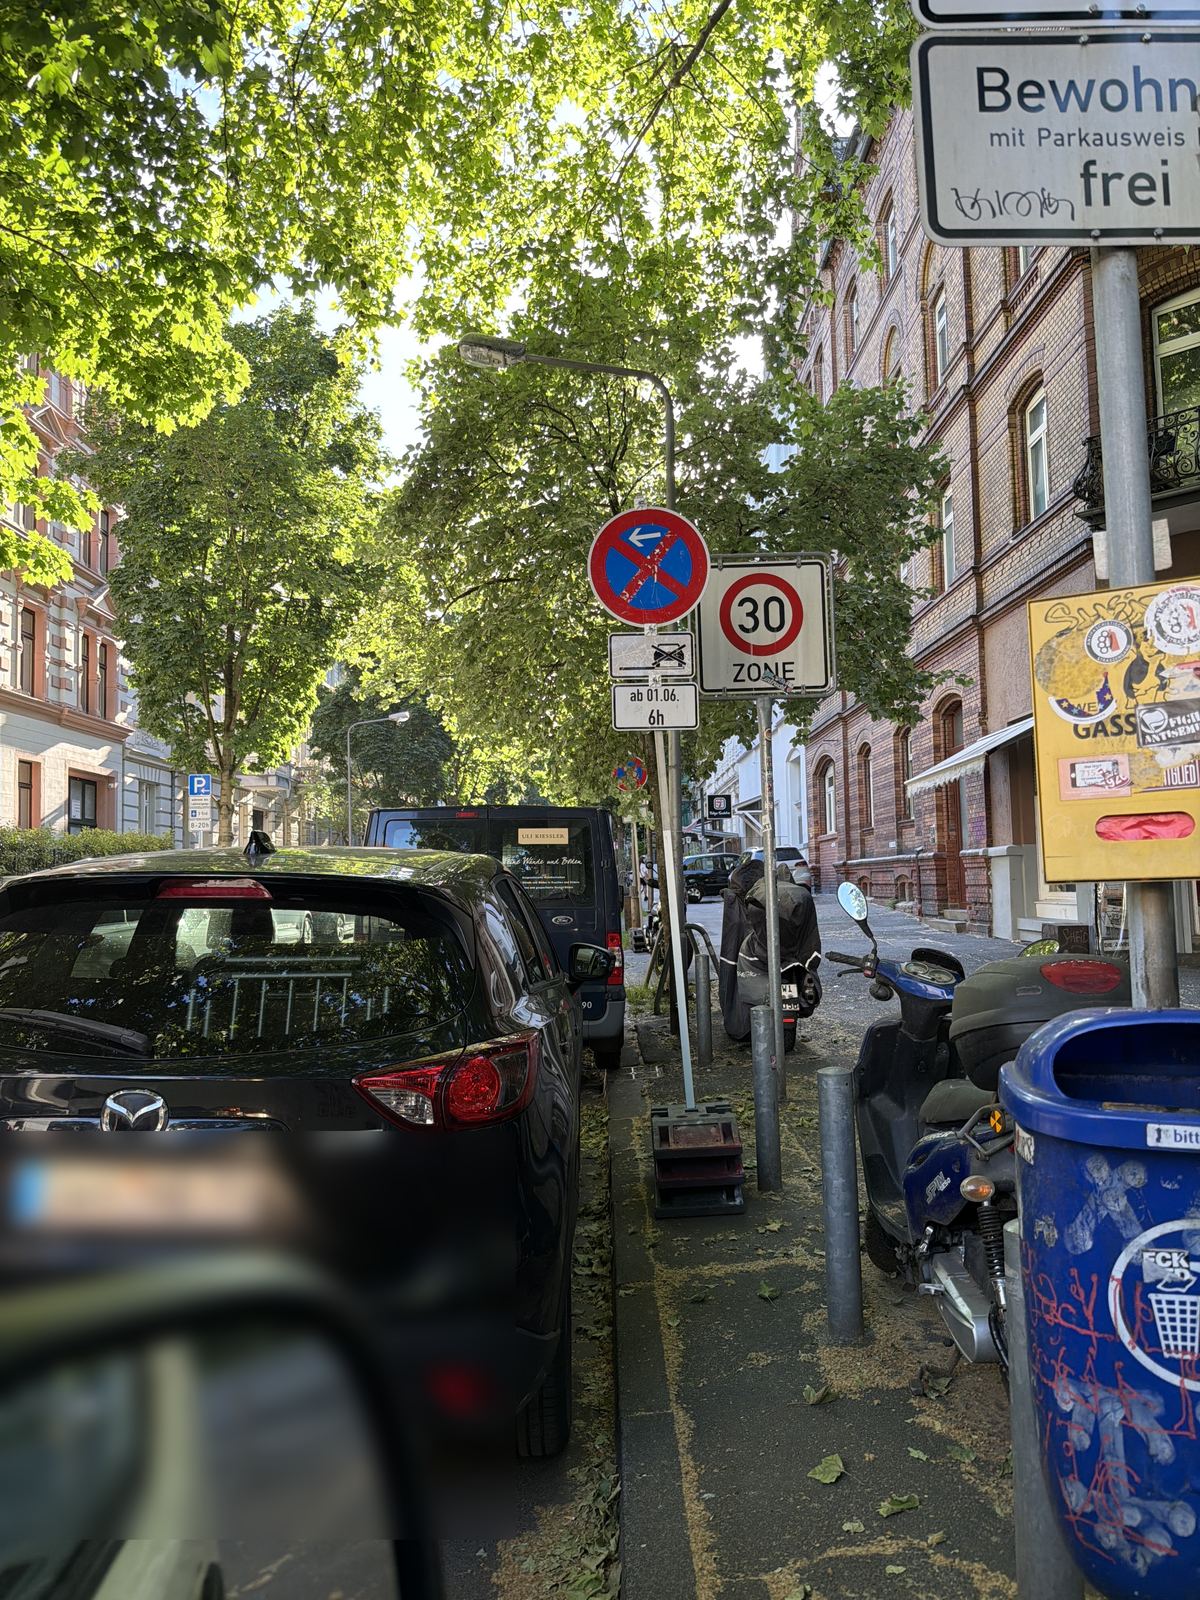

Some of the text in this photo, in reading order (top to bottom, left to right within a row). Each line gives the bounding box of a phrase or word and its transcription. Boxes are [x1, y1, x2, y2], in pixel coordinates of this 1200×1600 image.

[976, 65, 1199, 113] Bewohn
[990, 128, 1025, 147] mit
[1037, 127, 1185, 147] Parkausweis
[1080, 159, 1171, 207] frei
[737, 596, 785, 634] 30
[733, 662, 796, 683] ZONE
[630, 688, 680, 702] ab 01.06.
[648, 709, 665, 726] 6h
